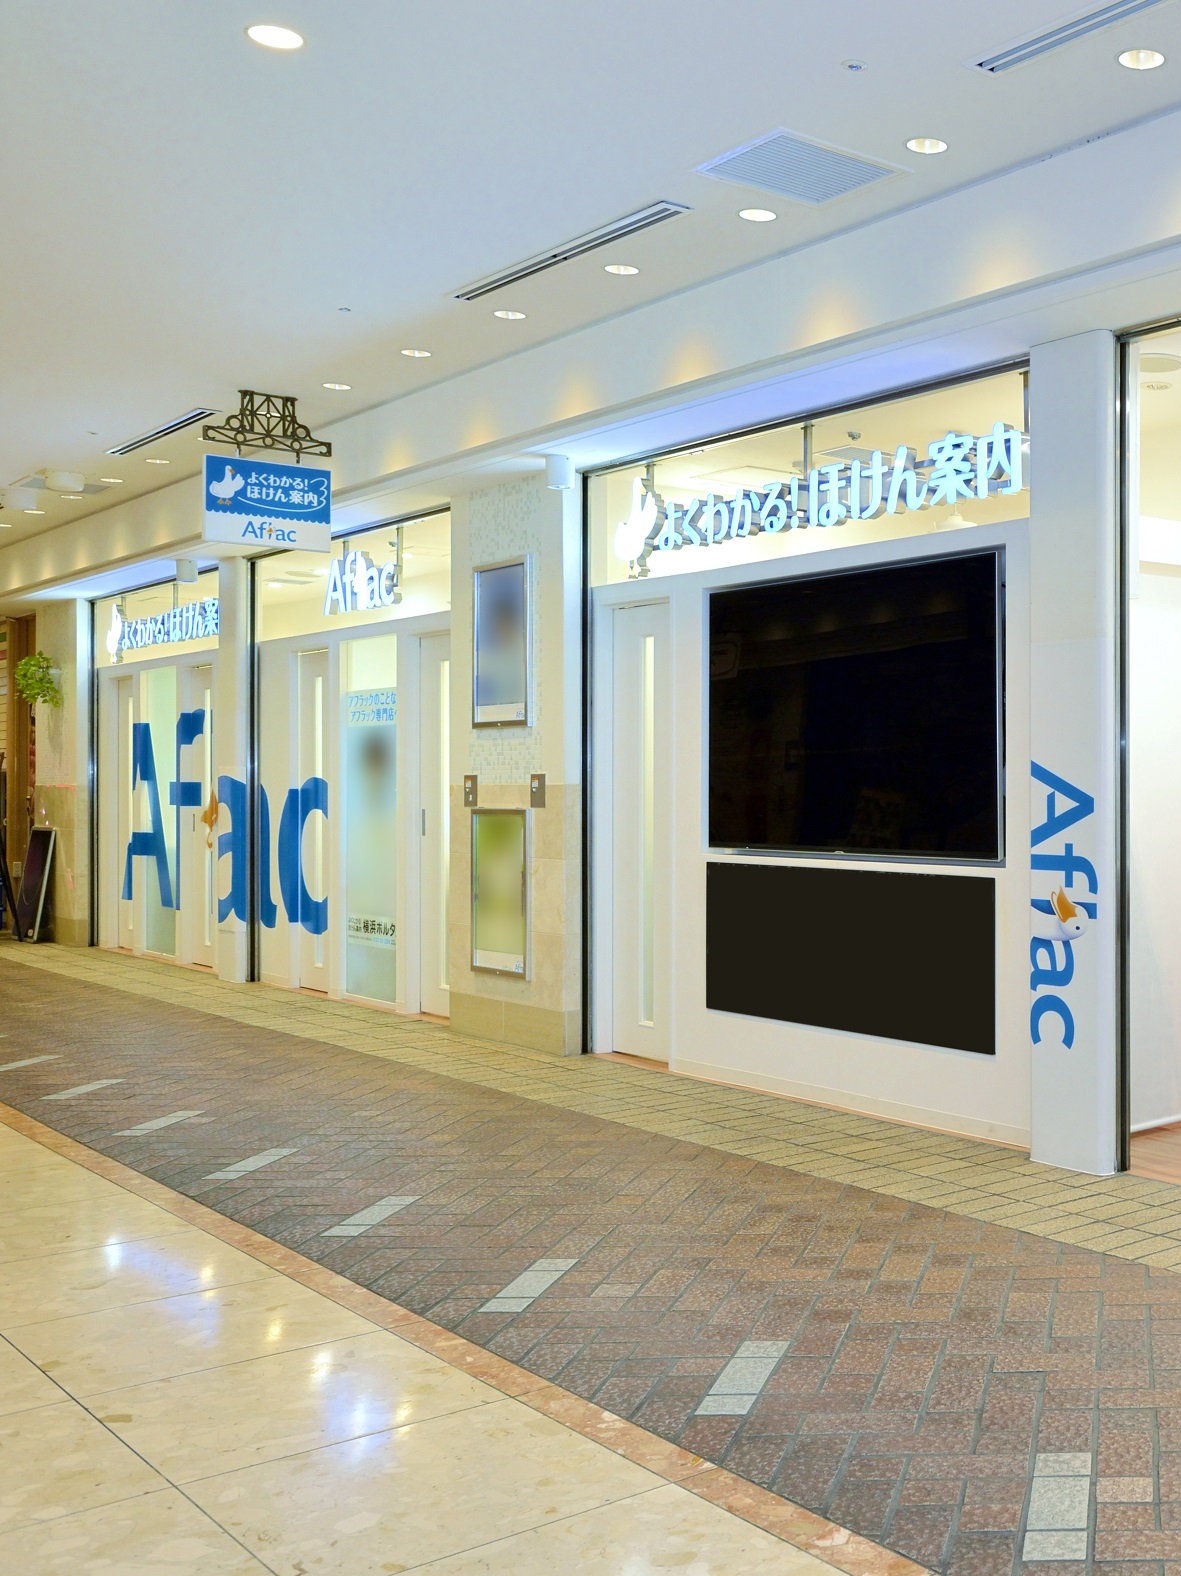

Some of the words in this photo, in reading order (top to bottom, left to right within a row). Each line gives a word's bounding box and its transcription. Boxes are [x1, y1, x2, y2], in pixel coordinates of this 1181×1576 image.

[247, 472, 309, 490] よくわかる!
[247, 485, 318, 506] ほけん案内
[659, 421, 1023, 551] よくわかる!ほけん案内
[121, 599, 219, 650] よくわかる!ほけん案
[351, 707, 397, 722] アフラック専門店
[121, 708, 328, 935] Afac
[1031, 760, 1099, 1050] Aflac
[363, 918, 396, 937] 横浜ポルタ
